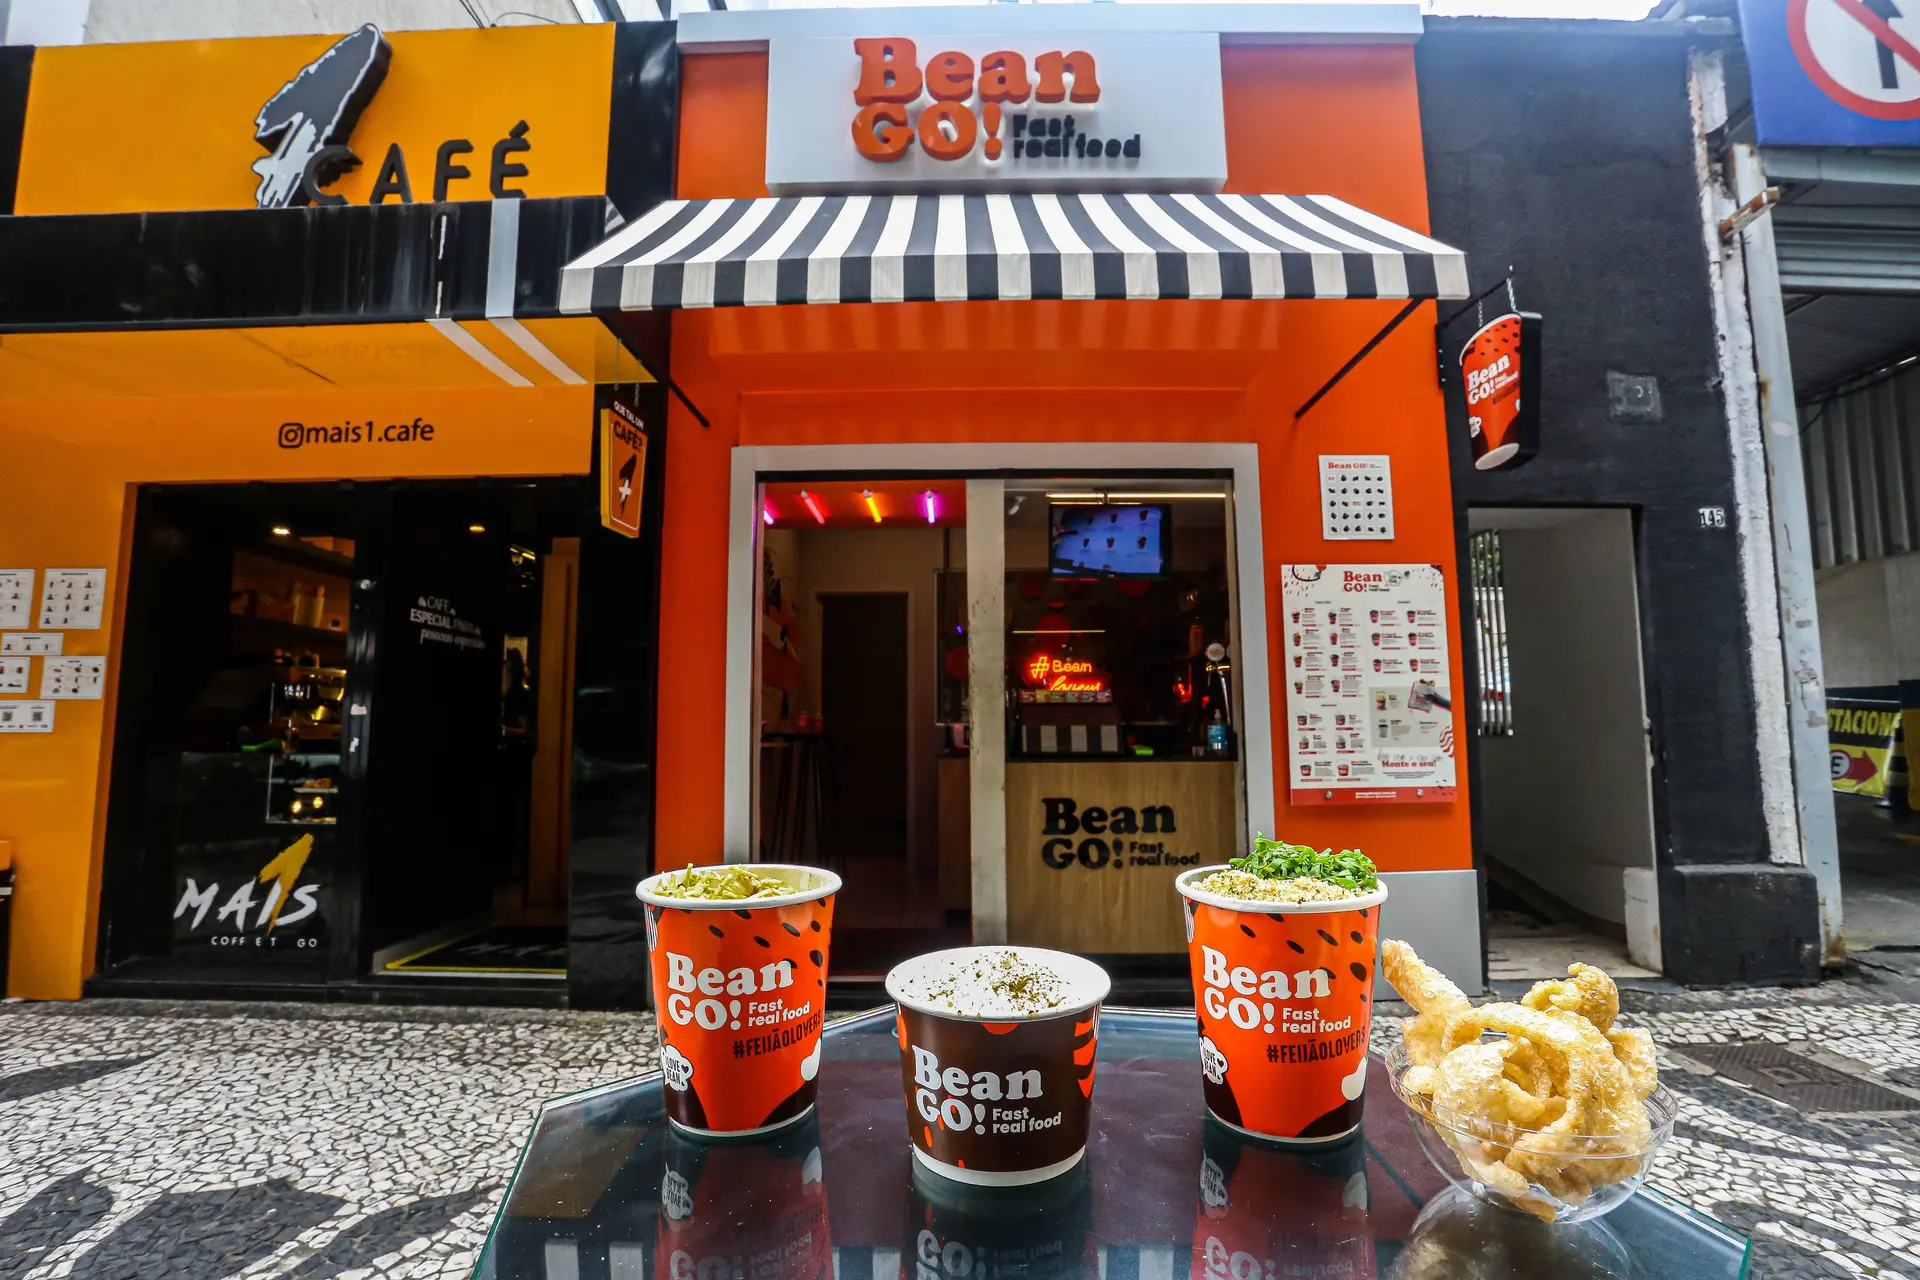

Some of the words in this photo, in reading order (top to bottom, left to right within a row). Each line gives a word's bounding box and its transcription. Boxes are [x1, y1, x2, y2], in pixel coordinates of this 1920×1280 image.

[853, 37, 1101, 106] Bean
[851, 101, 1004, 162] GO!
[1013, 114, 1075, 138] Fast
[1013, 134, 1071, 158] real
[1076, 134, 1141, 158] food
[301, 120, 531, 205] CAFÉ
[1467, 354, 1510, 391] Bean
[1468, 379, 1495, 405] GO!
[306, 417, 434, 444] mais1.cafe
[1700, 509, 1724, 527] 145
[1343, 571, 1382, 582] Bean
[1344, 583, 1367, 592] GO!
[1041, 797, 1176, 835] Bean
[1042, 837, 1123, 869] GO!
[1130, 841, 1164, 854] Fast
[1130, 853, 1161, 866] real
[1164, 852, 1200, 866] food
[173, 877, 320, 933] MAIS
[297, 938, 317, 947] GO
[666, 951, 793, 996] Bean
[1201, 945, 1331, 1000] Bean
[667, 993, 741, 1031] GO!
[748, 999, 783, 1015] Fast
[748, 1010, 779, 1026] real
[783, 1001, 811, 1023] food
[1204, 987, 1275, 1033] GO!
[1282, 1007, 1320, 1021] Fast
[1282, 1019, 1317, 1033] real
[1319, 1016, 1352, 1033] food
[912, 1044, 1043, 1101] Bean
[916, 1088, 986, 1135] GO!
[992, 1107, 1029, 1121] Fast
[992, 1120, 1025, 1134] real
[1028, 1112, 1062, 1131] food
